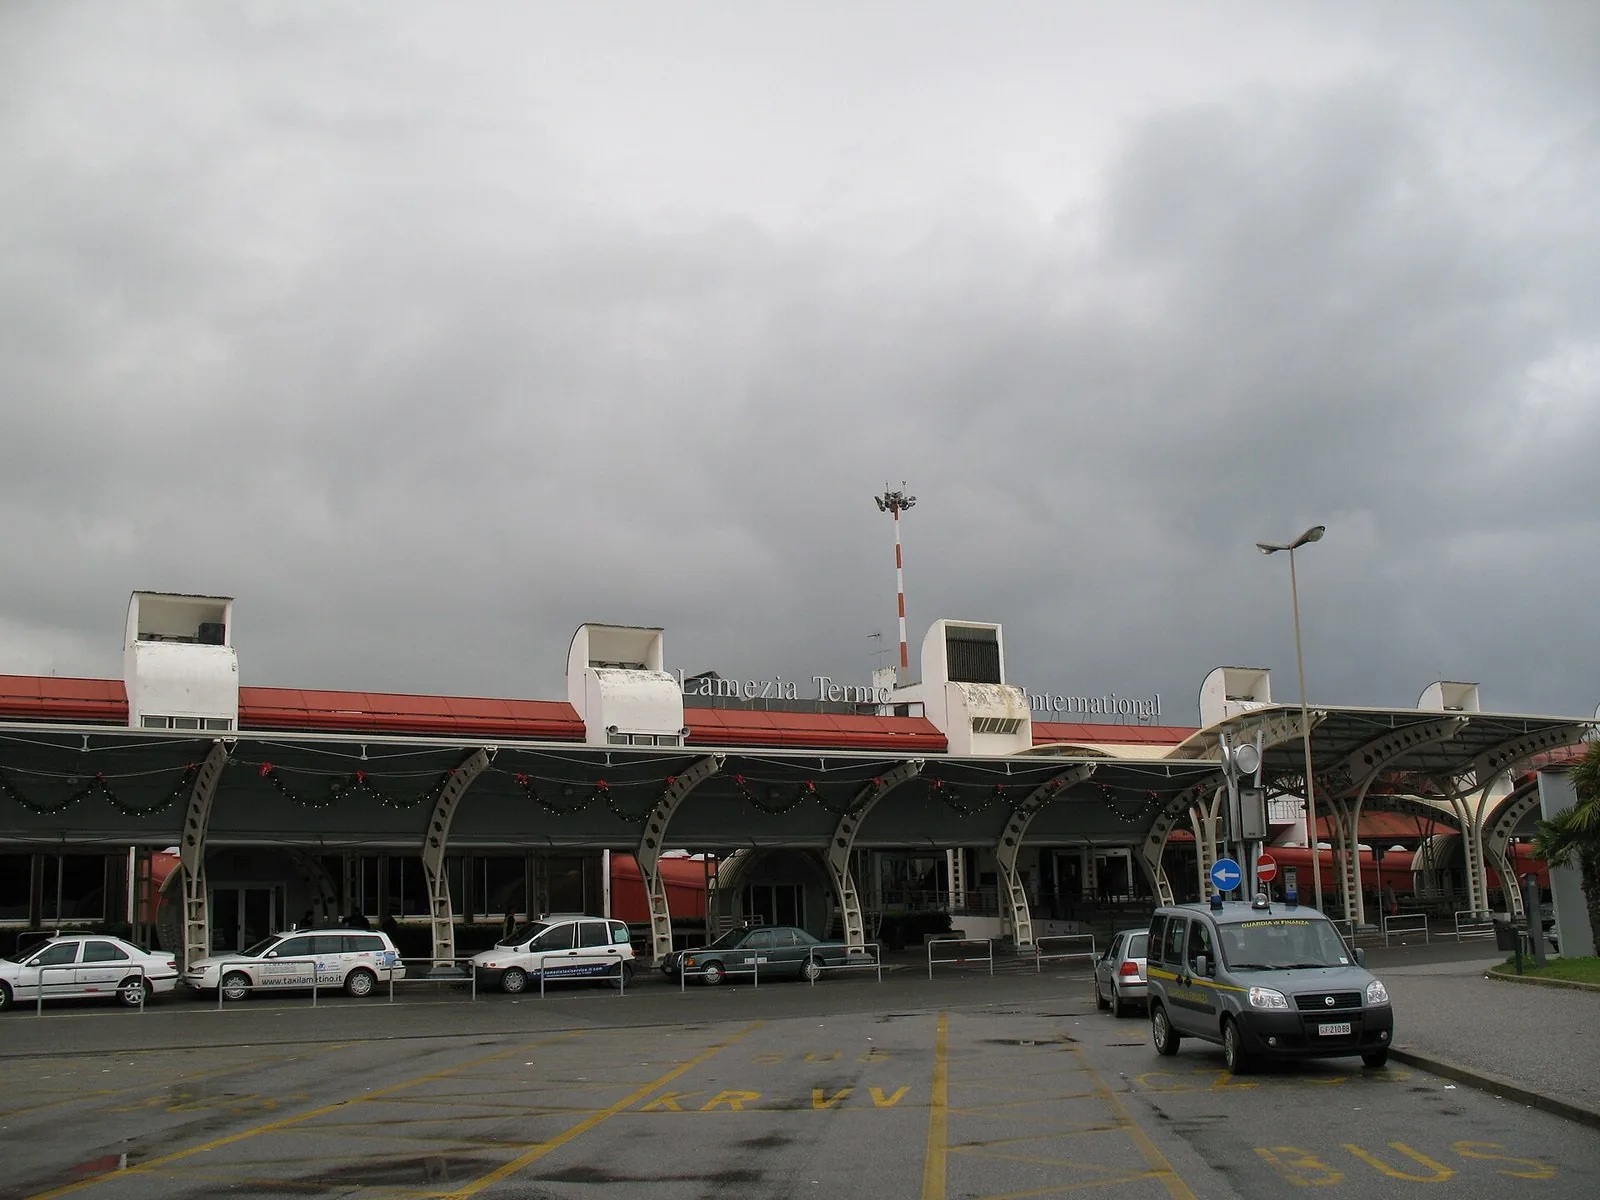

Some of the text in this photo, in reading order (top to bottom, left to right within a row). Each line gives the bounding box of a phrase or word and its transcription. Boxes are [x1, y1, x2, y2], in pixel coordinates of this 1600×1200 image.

[677, 669, 1161, 716] Lamezia Terme International
[1241, 920, 1273, 929] GUARDIA
[640, 1090, 762, 1112] KR
[1252, 1141, 1558, 1187] BUS
